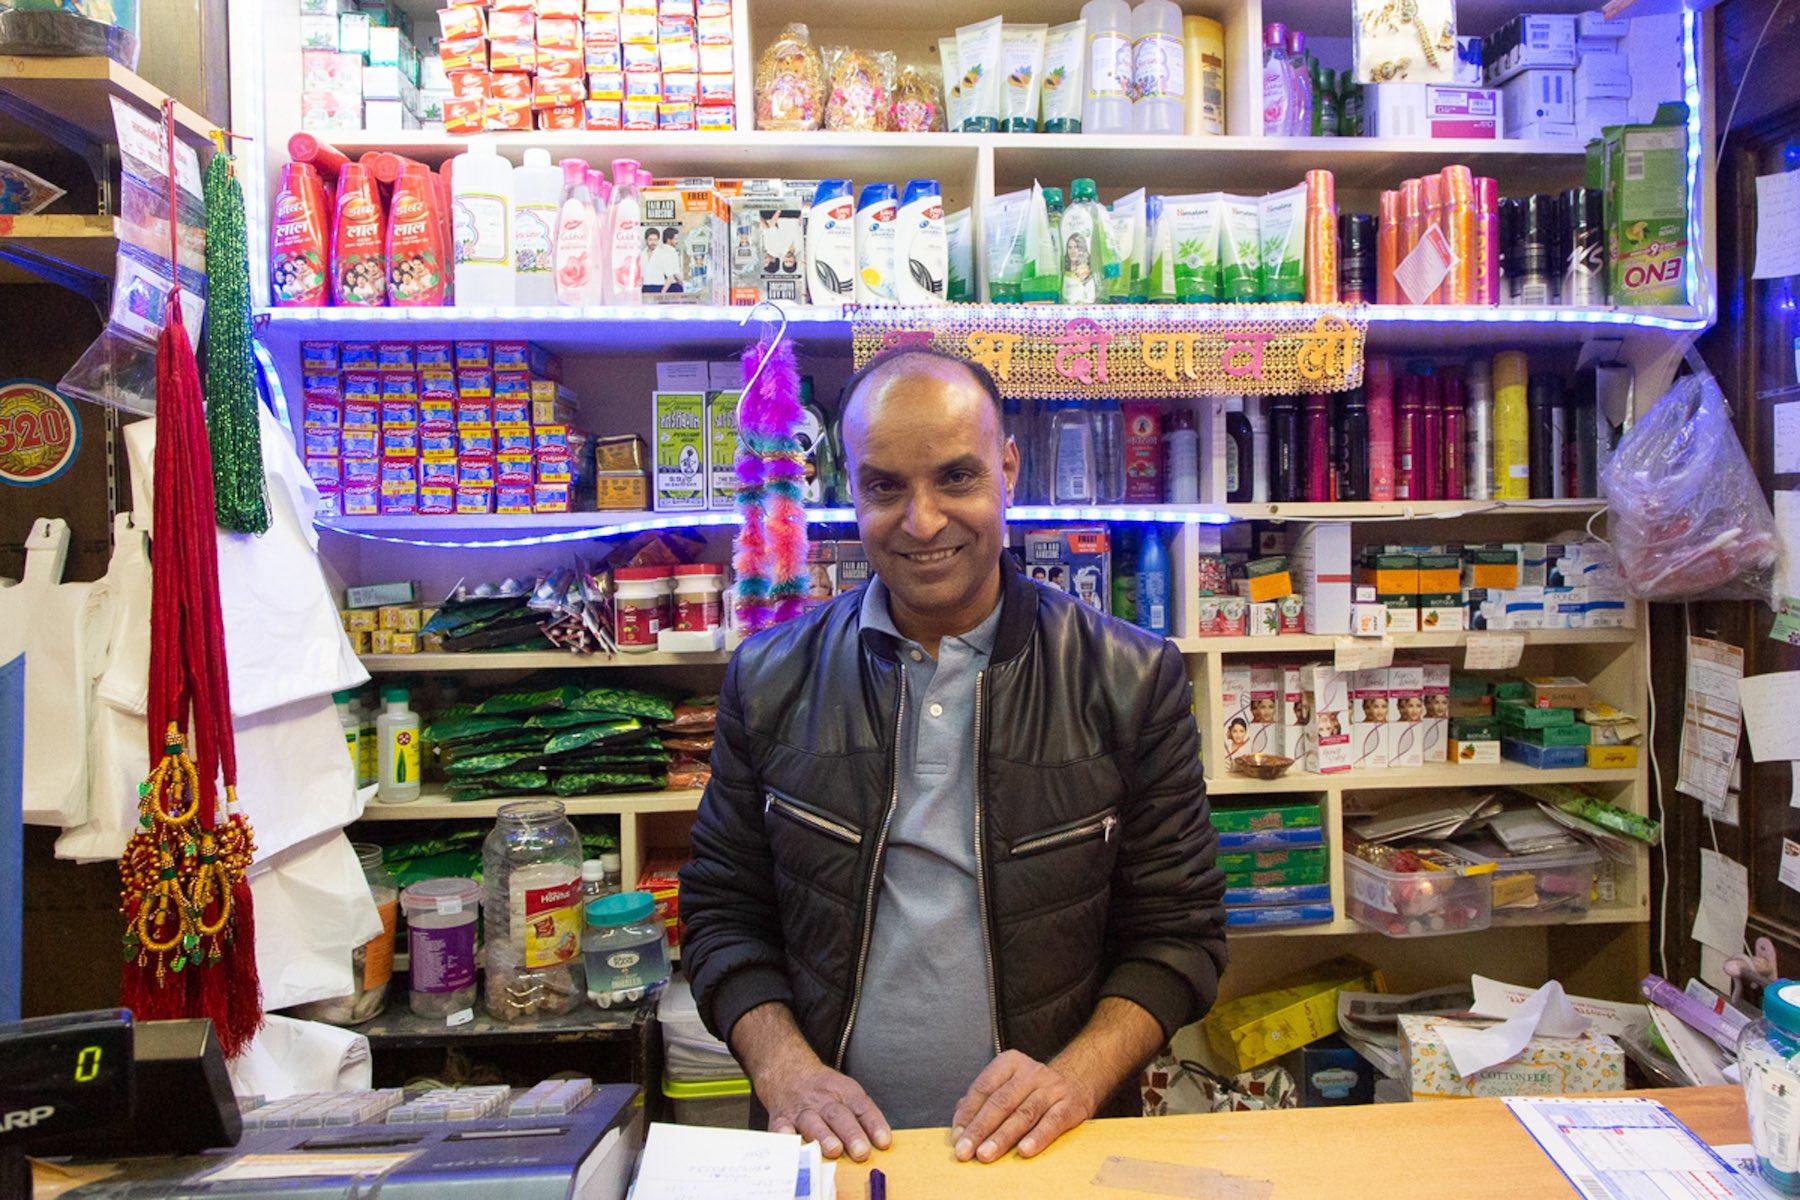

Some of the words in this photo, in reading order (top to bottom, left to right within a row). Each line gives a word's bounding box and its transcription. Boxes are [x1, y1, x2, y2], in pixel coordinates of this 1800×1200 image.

[276, 222, 308, 236] लाल
[346, 223, 379, 237] लाल
[393, 221, 426, 236] लाल
[1624, 257, 1683, 288] ENO
[75, 1046, 101, 1082] 0
[0, 1105, 55, 1133] RP
